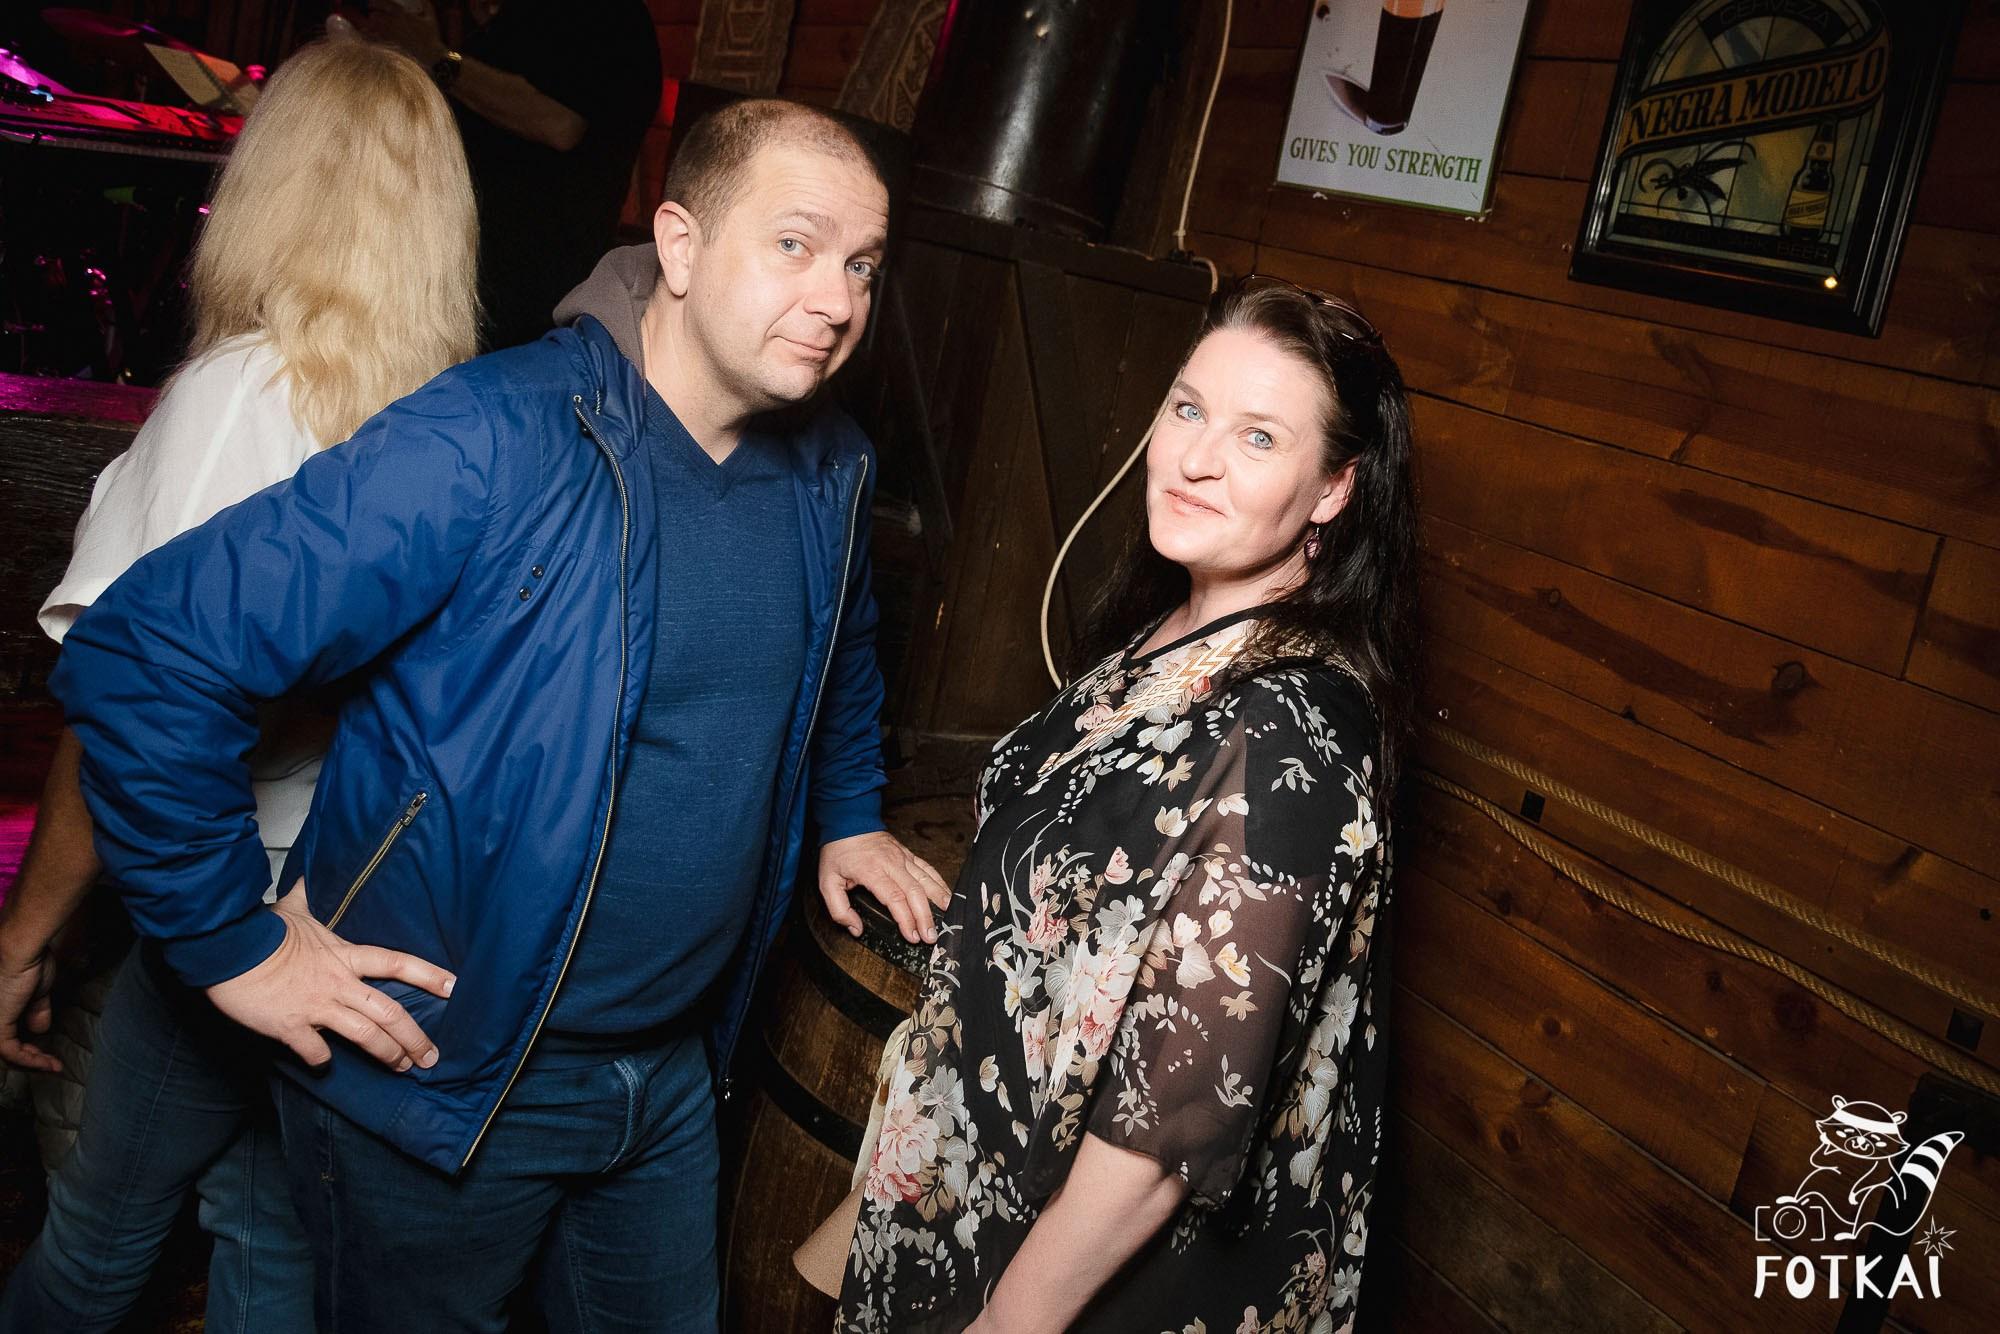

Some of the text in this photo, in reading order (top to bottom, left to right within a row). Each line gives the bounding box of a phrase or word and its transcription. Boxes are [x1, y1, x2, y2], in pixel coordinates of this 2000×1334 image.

[1623, 46, 1886, 148] NEGRA MODELO
[1290, 136, 1482, 183] GIVES YOU STRENGTH
